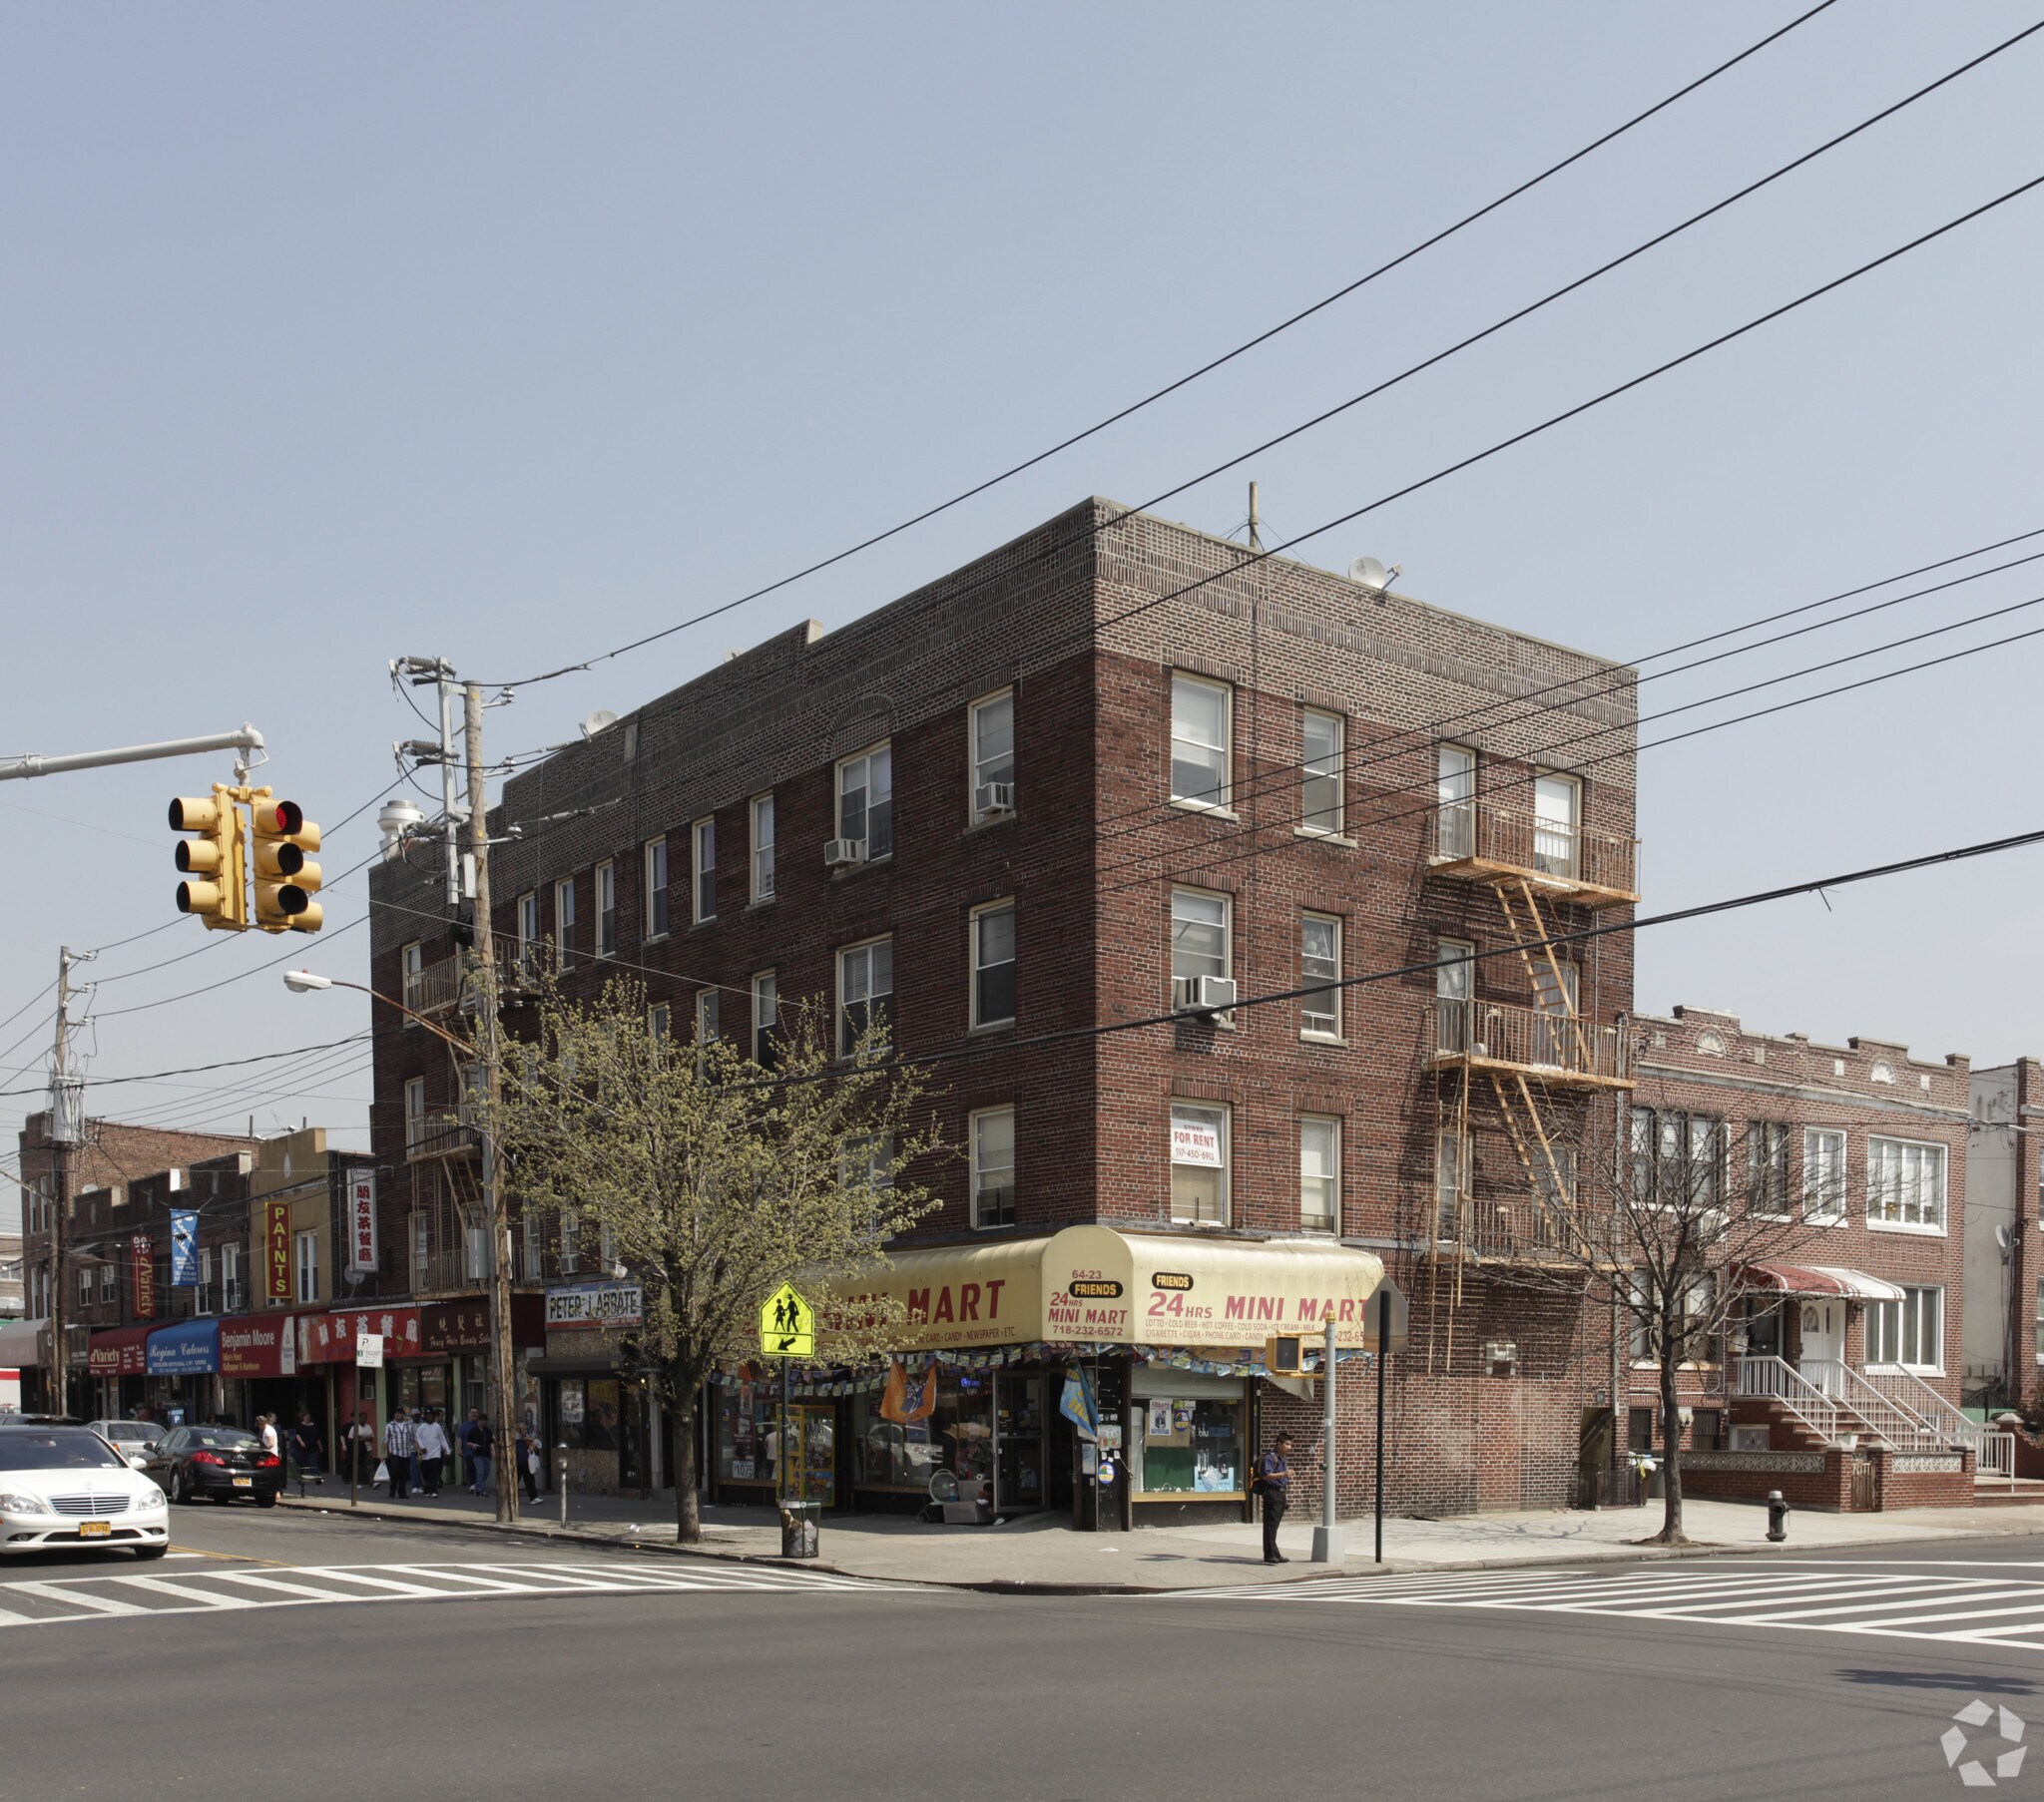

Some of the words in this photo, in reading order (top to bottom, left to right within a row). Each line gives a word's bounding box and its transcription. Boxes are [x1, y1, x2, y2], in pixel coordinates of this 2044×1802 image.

[1174, 1131, 1191, 1144] FOR
[1193, 1133, 1214, 1147] RENT
[273, 1207, 286, 1292] PAINTS
[1072, 1269, 1102, 1279] 64-23
[1156, 1275, 1190, 1288] FRIENDS
[1074, 1284, 1117, 1295] FRIENDS
[550, 1295, 582, 1319] PETER
[906, 1279, 1005, 1326] MART
[1148, 1291, 1184, 1317] 24
[1186, 1306, 1213, 1318] HRS
[1225, 1295, 1284, 1320] MINI
[1048, 1308, 1080, 1323] MINI
[1086, 1309, 1128, 1324] MART
[1053, 1325, 1123, 1336] 718-232-6572
[1146, 1318, 1165, 1327] LOTTO
[1168, 1319, 1184, 1328] COLD
[1202, 1321, 1213, 1330] HOT
[1215, 1321, 1234, 1330] COFFEE
[1238, 1322, 1253, 1331] COLD
[222, 1329, 252, 1352] Benjamin
[253, 1329, 274, 1346] Moore
[926, 1332, 940, 1342] CARD
[945, 1331, 963, 1342] CANDY
[967, 1328, 1000, 1340] NEWSPAPER
[1004, 1326, 1016, 1336] ETC.
[1146, 1329, 1178, 1338] CIGARETTE
[1226, 1331, 1241, 1340] CARD
[1245, 1332, 1264, 1341] CANDY
[150, 1344, 176, 1361] Regina
[181, 1342, 210, 1357] Caterers
[1198, 1425, 1210, 1437] blu
